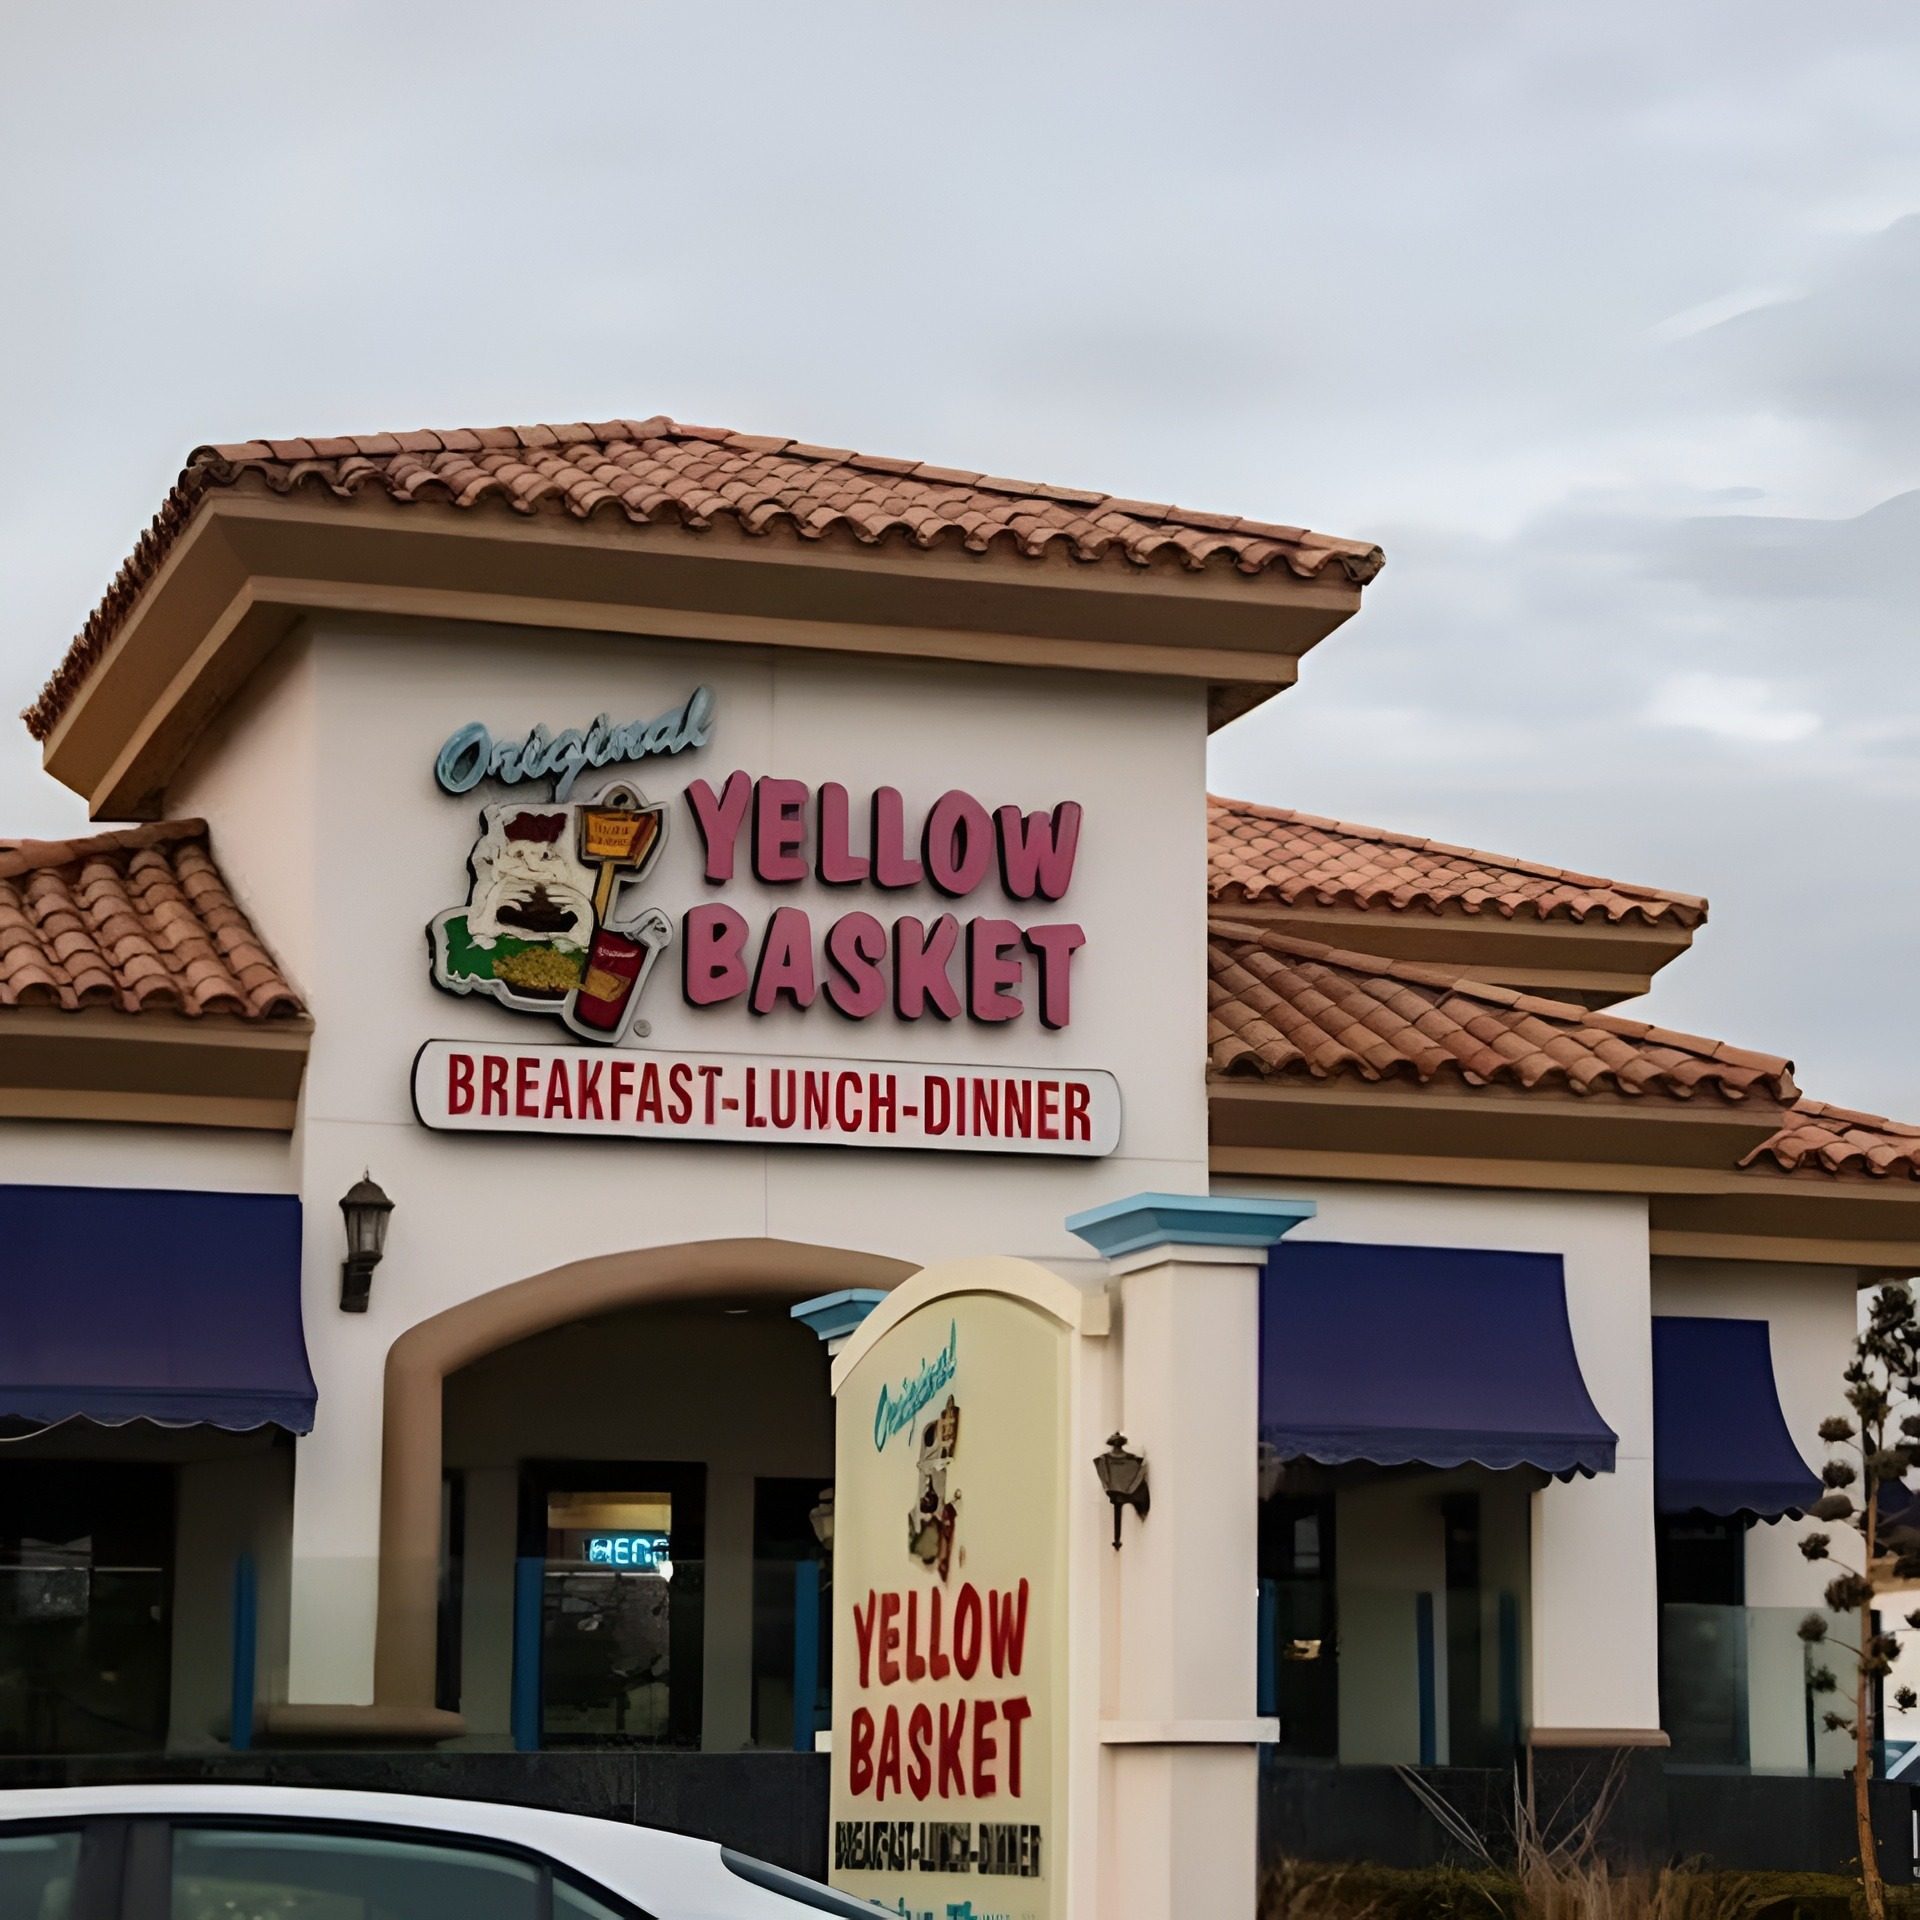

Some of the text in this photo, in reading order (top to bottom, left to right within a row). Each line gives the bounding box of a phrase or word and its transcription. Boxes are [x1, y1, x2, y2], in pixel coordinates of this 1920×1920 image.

[436, 684, 714, 802] Original
[684, 770, 1082, 900] YELLOW
[684, 902, 1086, 1030] BASKET
[447, 1053, 1092, 1141] BREAKFAST-LUNCH-DINNER
[853, 1577, 1029, 1689] YELLOW
[850, 1696, 1032, 1802] BASKET
